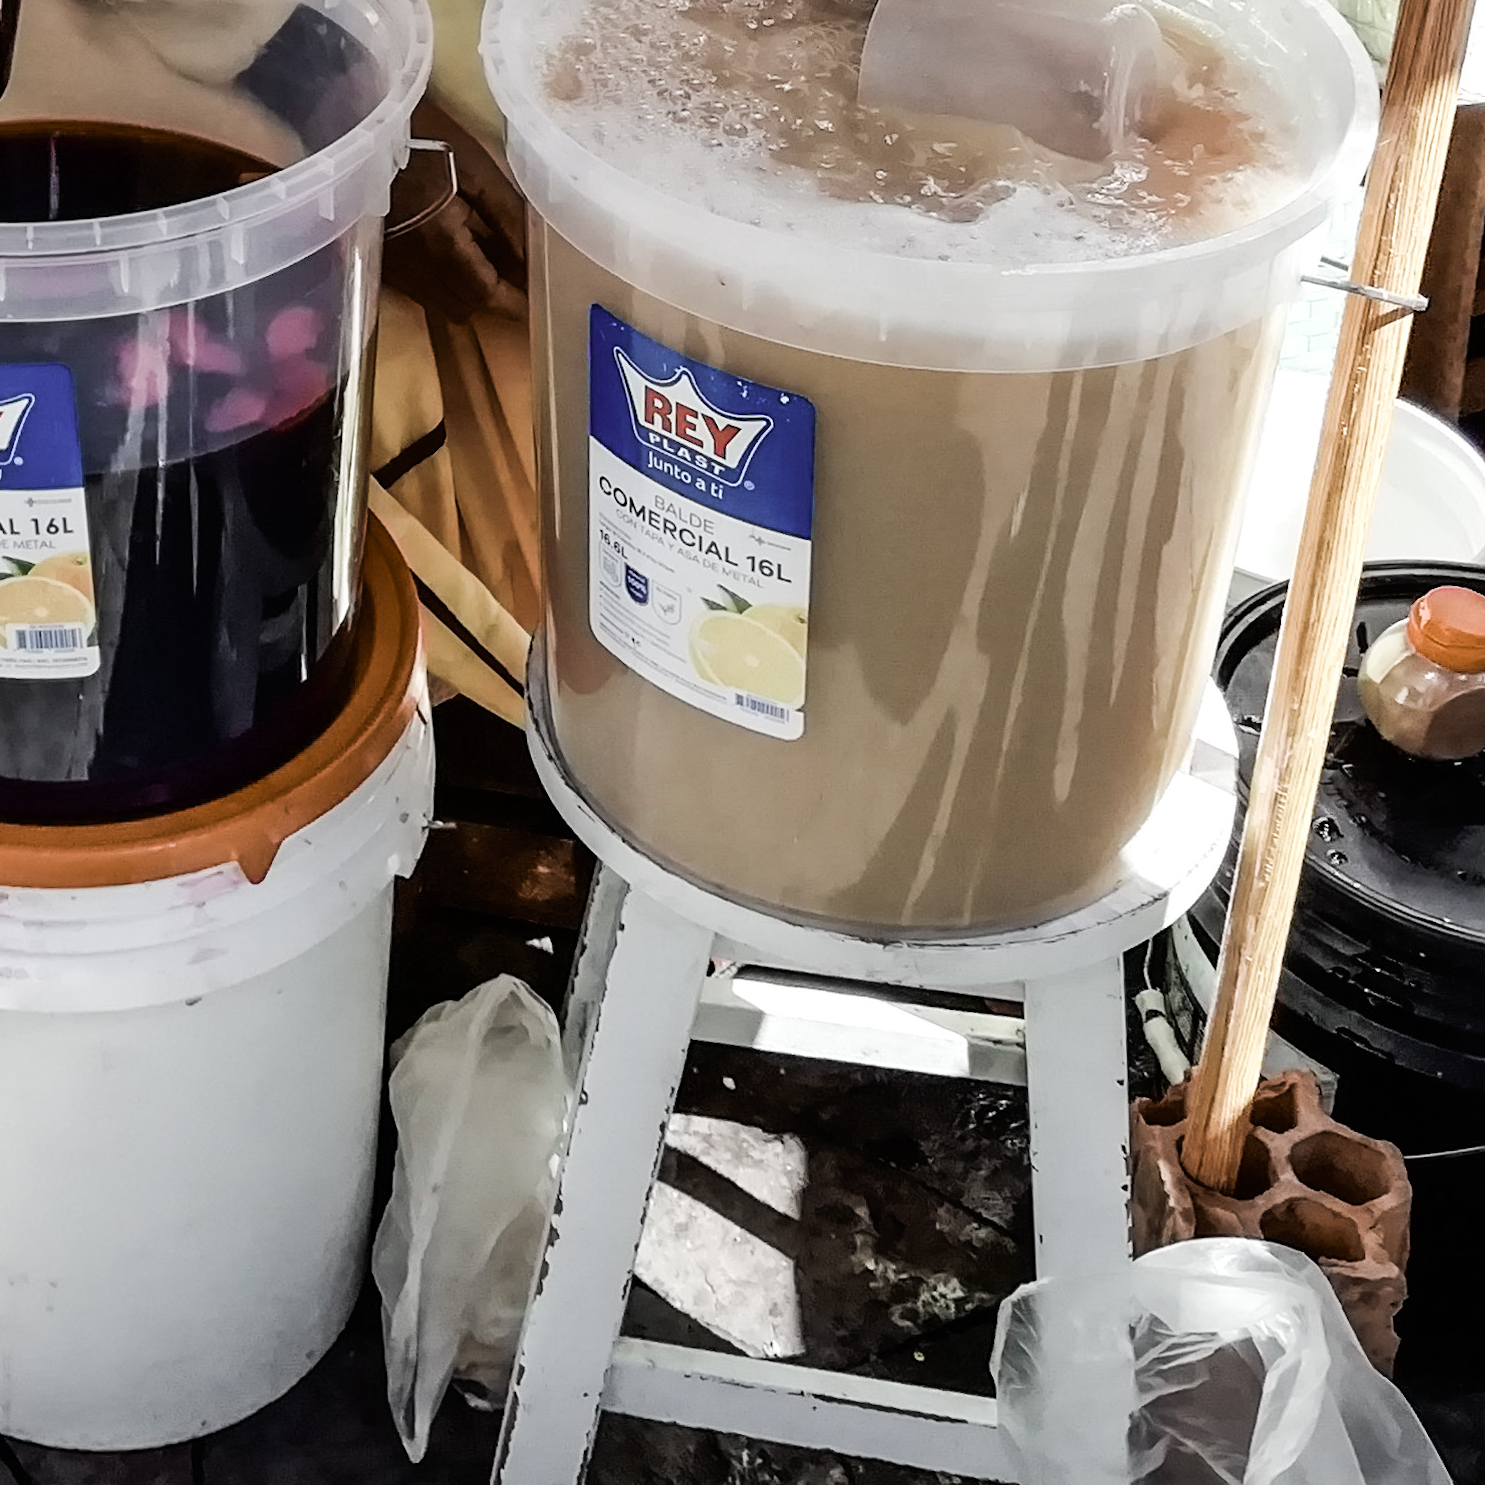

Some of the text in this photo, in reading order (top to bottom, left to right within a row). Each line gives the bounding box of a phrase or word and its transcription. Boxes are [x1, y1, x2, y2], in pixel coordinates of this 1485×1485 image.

[644, 385, 742, 460] REY
[648, 451, 724, 500] Junto a ti
[649, 432, 726, 476] PLAST
[30, 516, 74, 535] 16L
[599, 476, 739, 567] COMERCIAL
[746, 554, 793, 583] 16L
[654, 494, 715, 535] BALDE
[13, 539, 57, 550] METAL
[599, 529, 628, 560] 16.6L
[616, 509, 637, 529] CON
[639, 525, 665, 546] TAPA
[677, 548, 700, 564] ASA
[702, 558, 719, 573] DE
[722, 567, 764, 589] METAL
